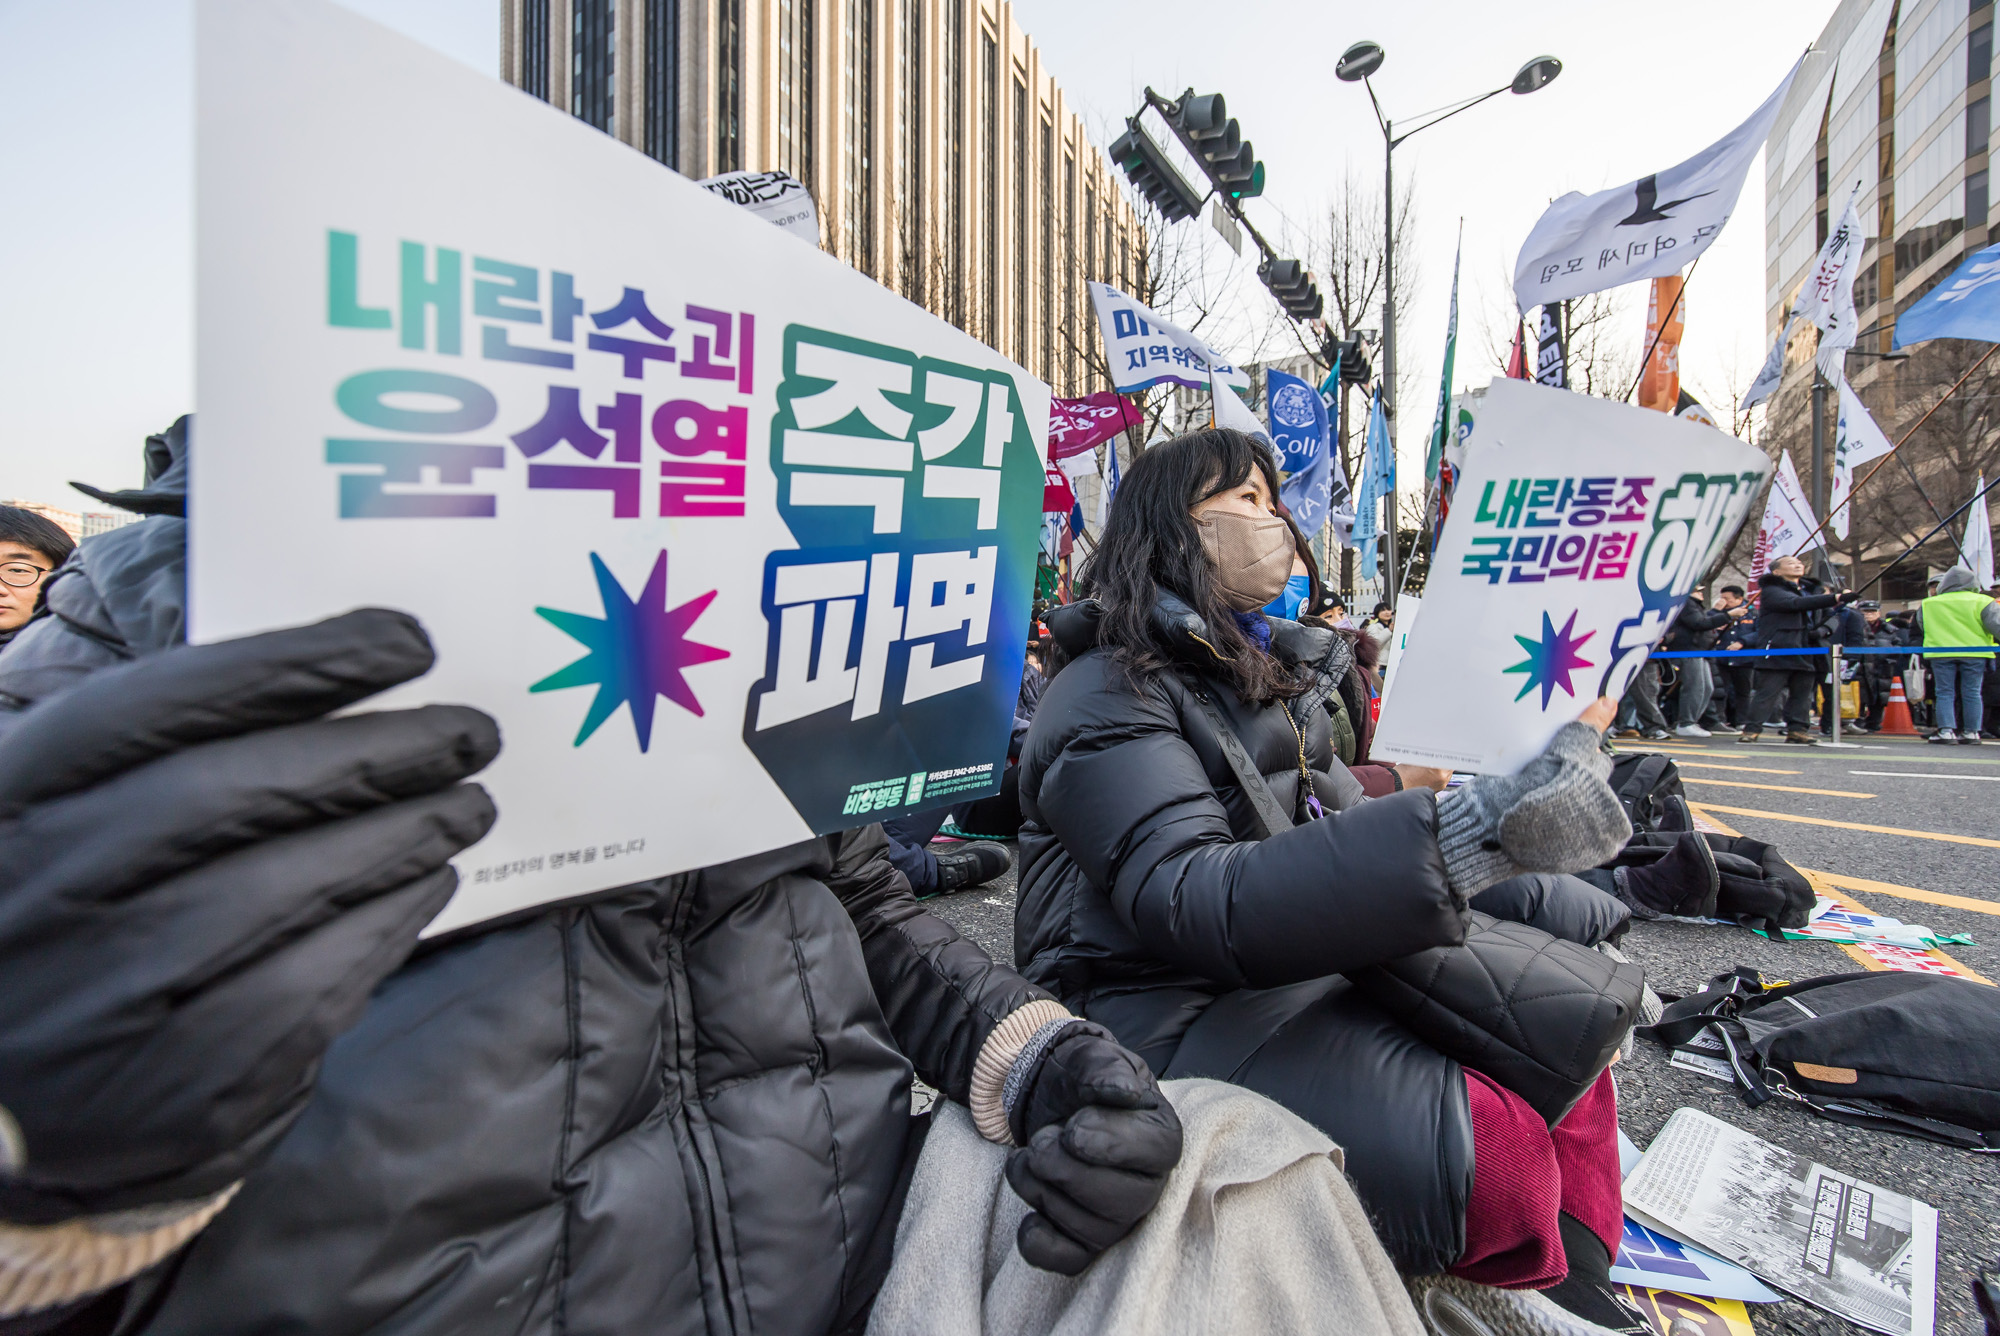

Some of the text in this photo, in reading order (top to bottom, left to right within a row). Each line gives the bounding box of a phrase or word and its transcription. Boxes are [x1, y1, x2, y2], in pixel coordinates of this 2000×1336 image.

[327, 227, 755, 395] 내란수괴
[323, 368, 749, 520] 윤석열
[782, 340, 1014, 534] 즉각
[1473, 476, 1656, 529] 내란동조
[1461, 531, 1639, 585] 국민의힘
[755, 545, 998, 732] 파면
[549, 847, 598, 870] 명복을
[603, 837, 646, 861] 빕니다
